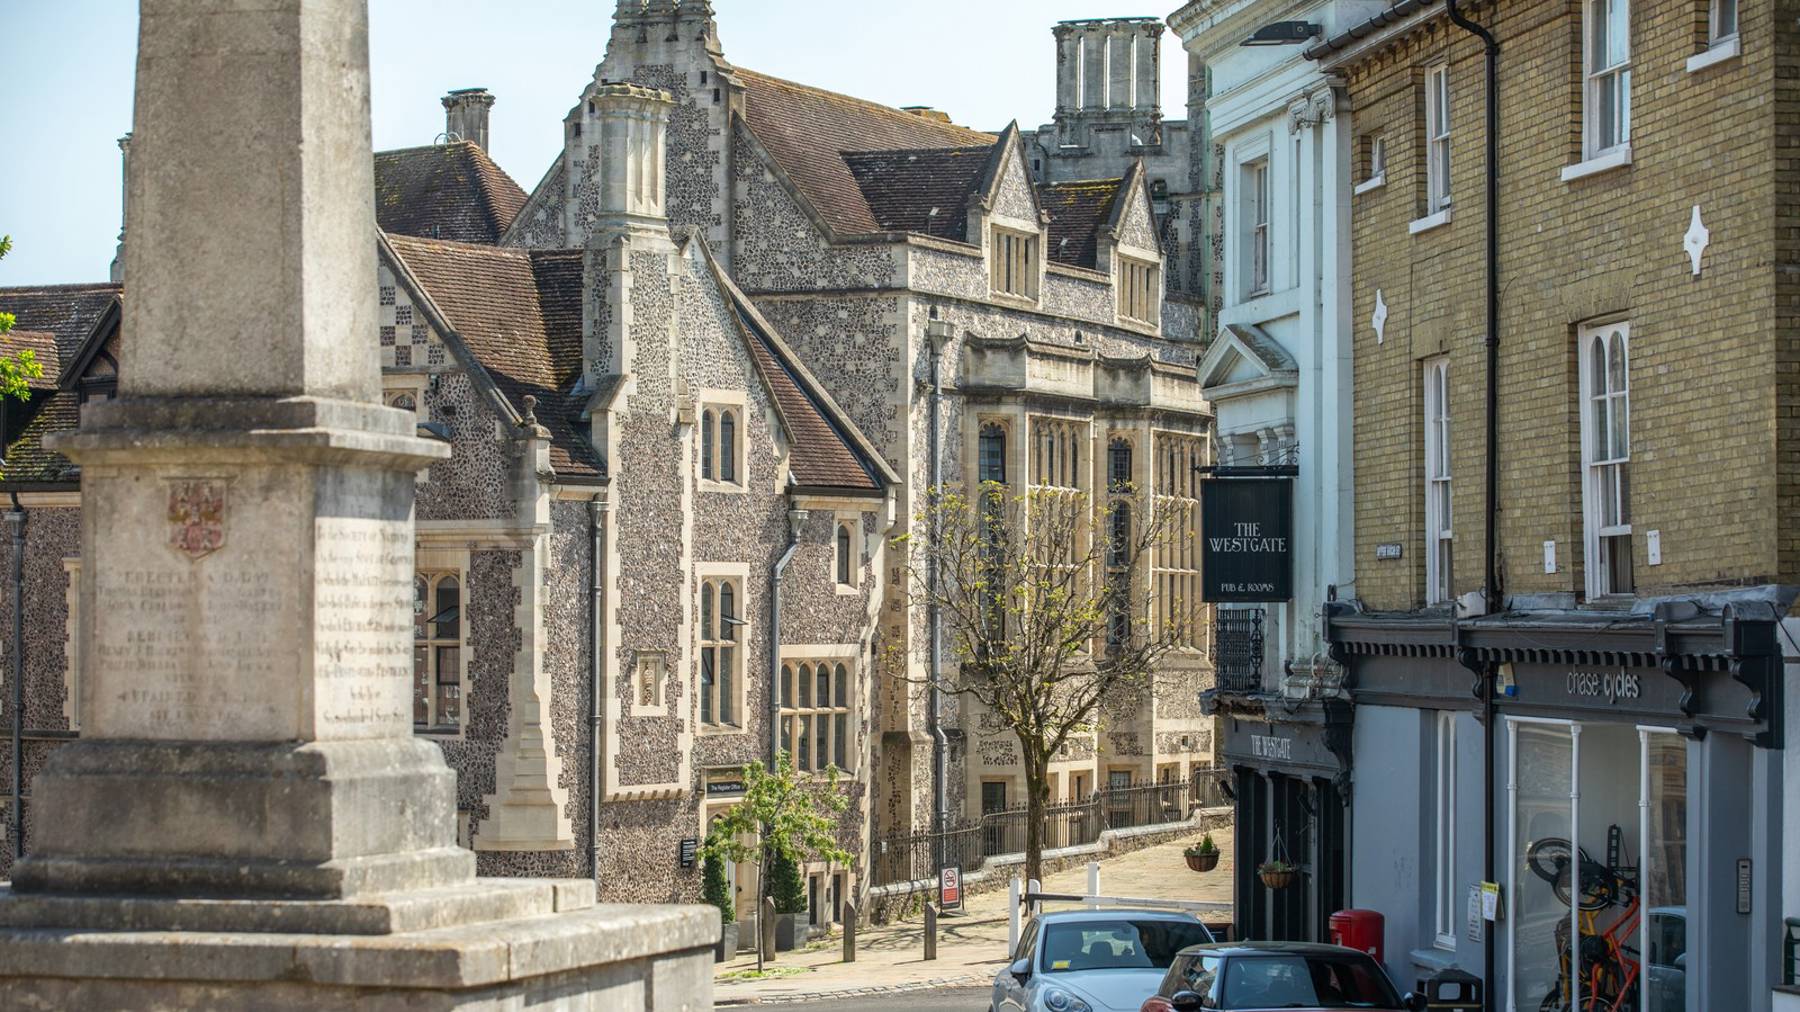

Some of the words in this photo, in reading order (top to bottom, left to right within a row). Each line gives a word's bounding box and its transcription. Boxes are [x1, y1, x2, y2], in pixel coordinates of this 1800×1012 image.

[1234, 522, 1261, 537] THE
[1209, 538, 1287, 553] WESTGATE
[1221, 583, 1236, 592] PUB
[1238, 583, 1246, 592] &
[1247, 583, 1275, 592] ROOMS
[1566, 664, 1599, 696] chase
[1603, 665, 1639, 704] cycles
